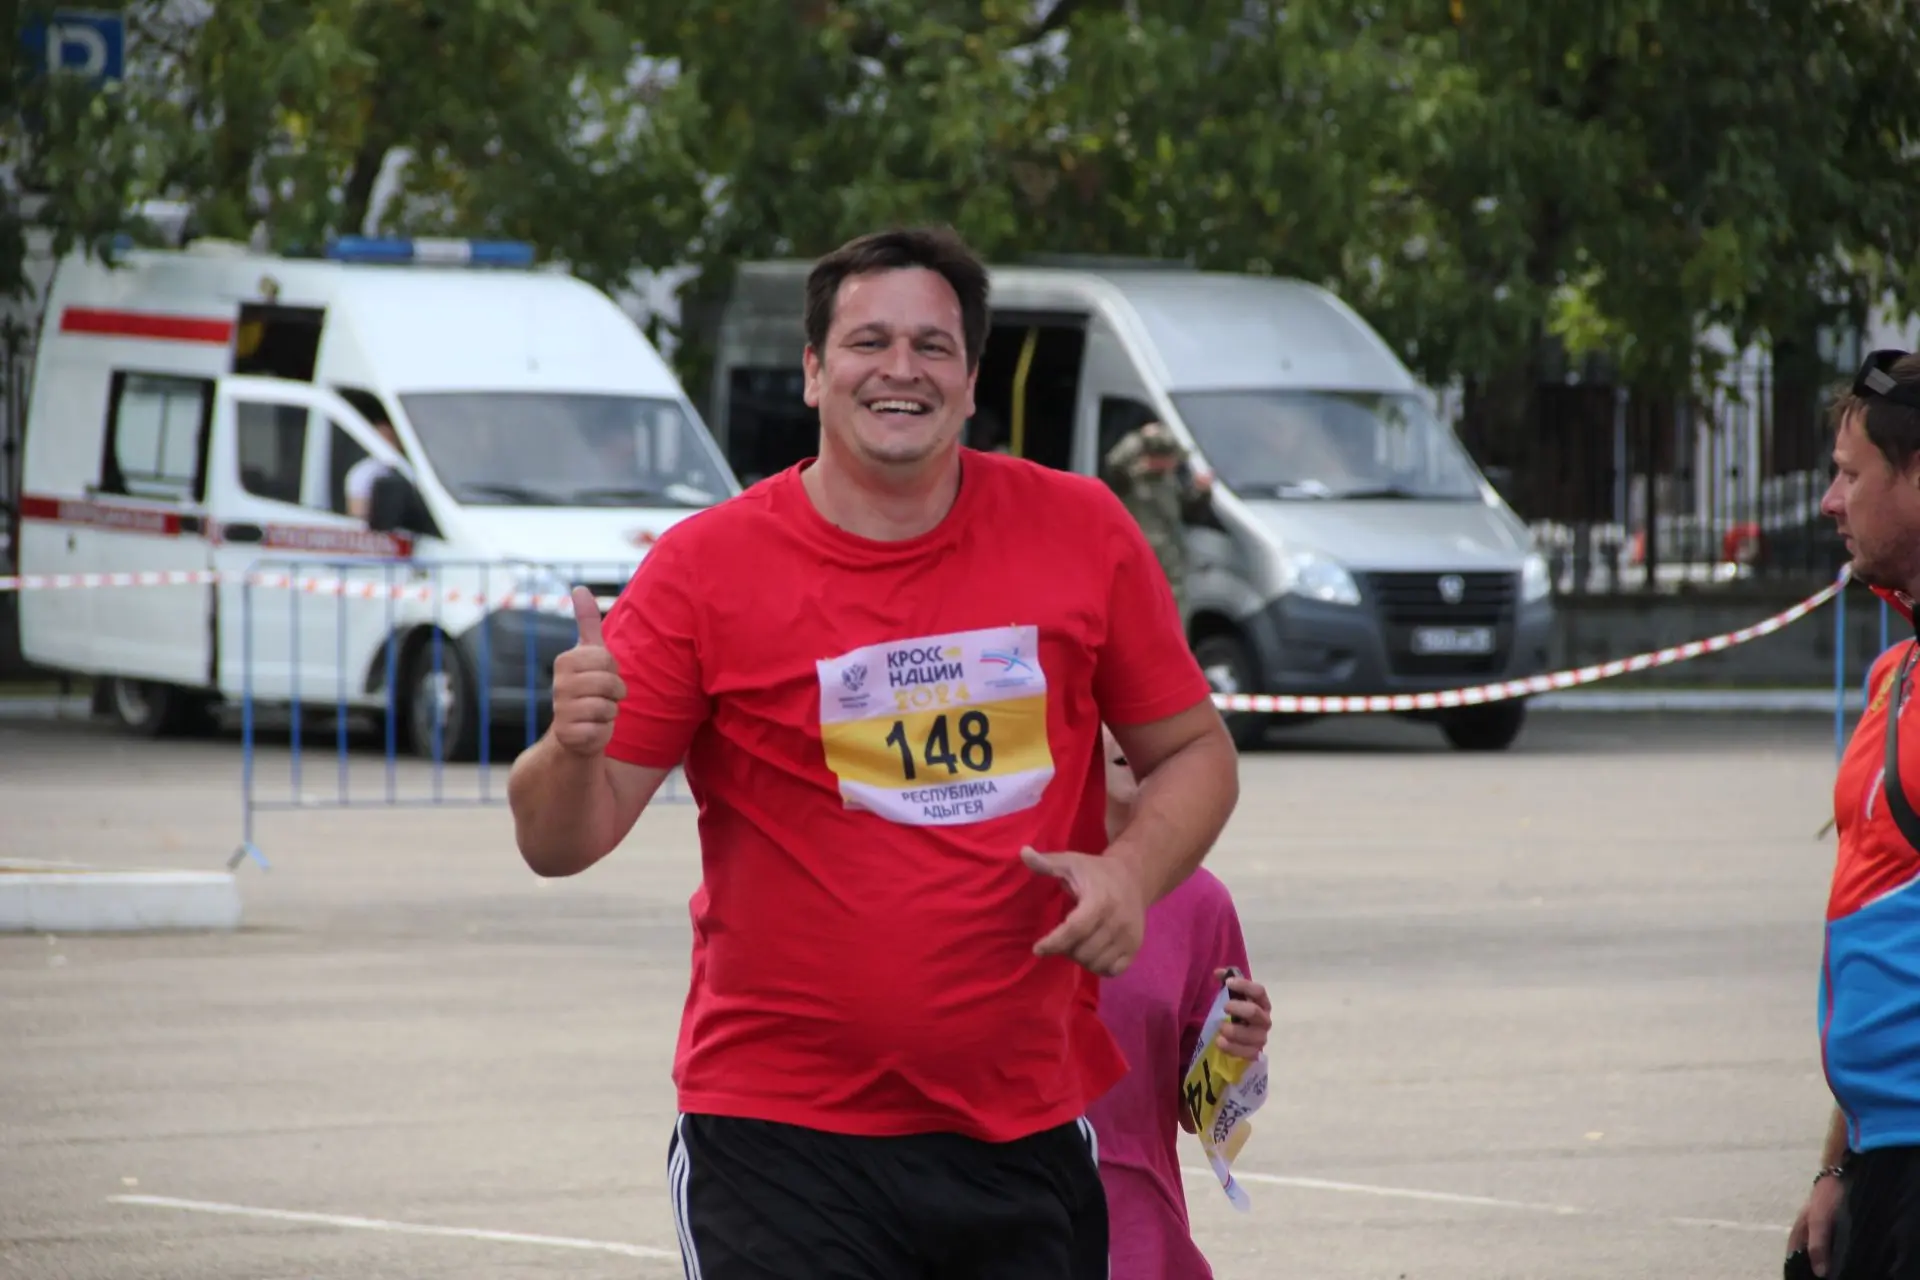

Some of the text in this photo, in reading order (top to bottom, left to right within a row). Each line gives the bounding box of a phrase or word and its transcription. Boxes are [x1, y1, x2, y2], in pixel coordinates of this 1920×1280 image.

[887, 645, 943, 668] КРОСС
[889, 662, 964, 687] НАЦИИ
[894, 686, 970, 710] 2024
[886, 711, 993, 780] 148
[902, 780, 998, 804] РЕСПУБЛИКА
[923, 800, 984, 819] АДЫГЕЯ
